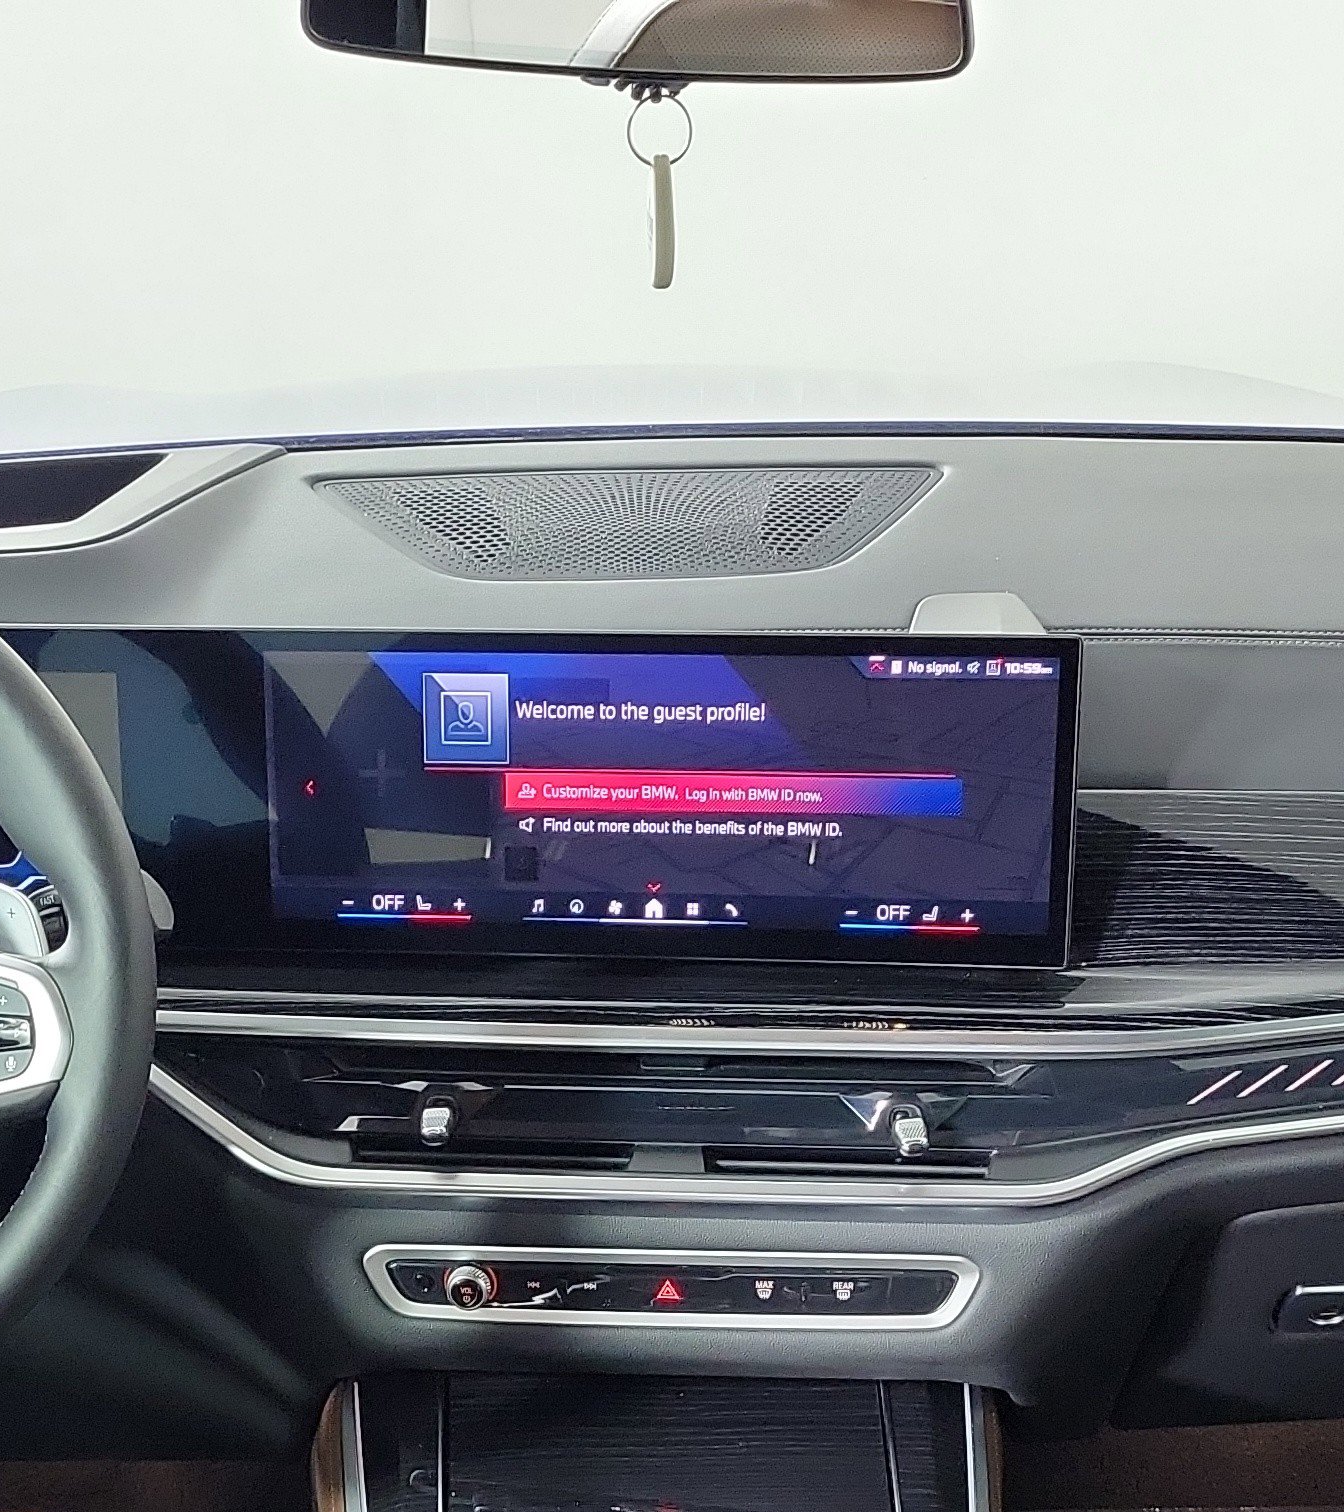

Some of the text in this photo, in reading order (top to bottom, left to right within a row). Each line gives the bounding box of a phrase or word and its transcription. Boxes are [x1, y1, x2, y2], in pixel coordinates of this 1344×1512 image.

[908, 661, 924, 673] No
[515, 700, 766, 725] Welcome to the guest profile!
[542, 783, 609, 799] Customize
[611, 788, 639, 801] your
[641, 785, 679, 800] BMW.
[685, 787, 707, 802] Log
[722, 788, 746, 801] with
[748, 788, 779, 801] BMW
[781, 789, 794, 801] ID
[543, 817, 843, 837] Find out more about the benefits of the BMW ID.
[39, 894, 56, 906] FAST
[372, 894, 405, 911] OFF
[876, 904, 912, 921] OFF
[460, 1286, 473, 1294] VOL
[755, 1281, 774, 1289] MAX
[832, 1281, 854, 1290] REAR
